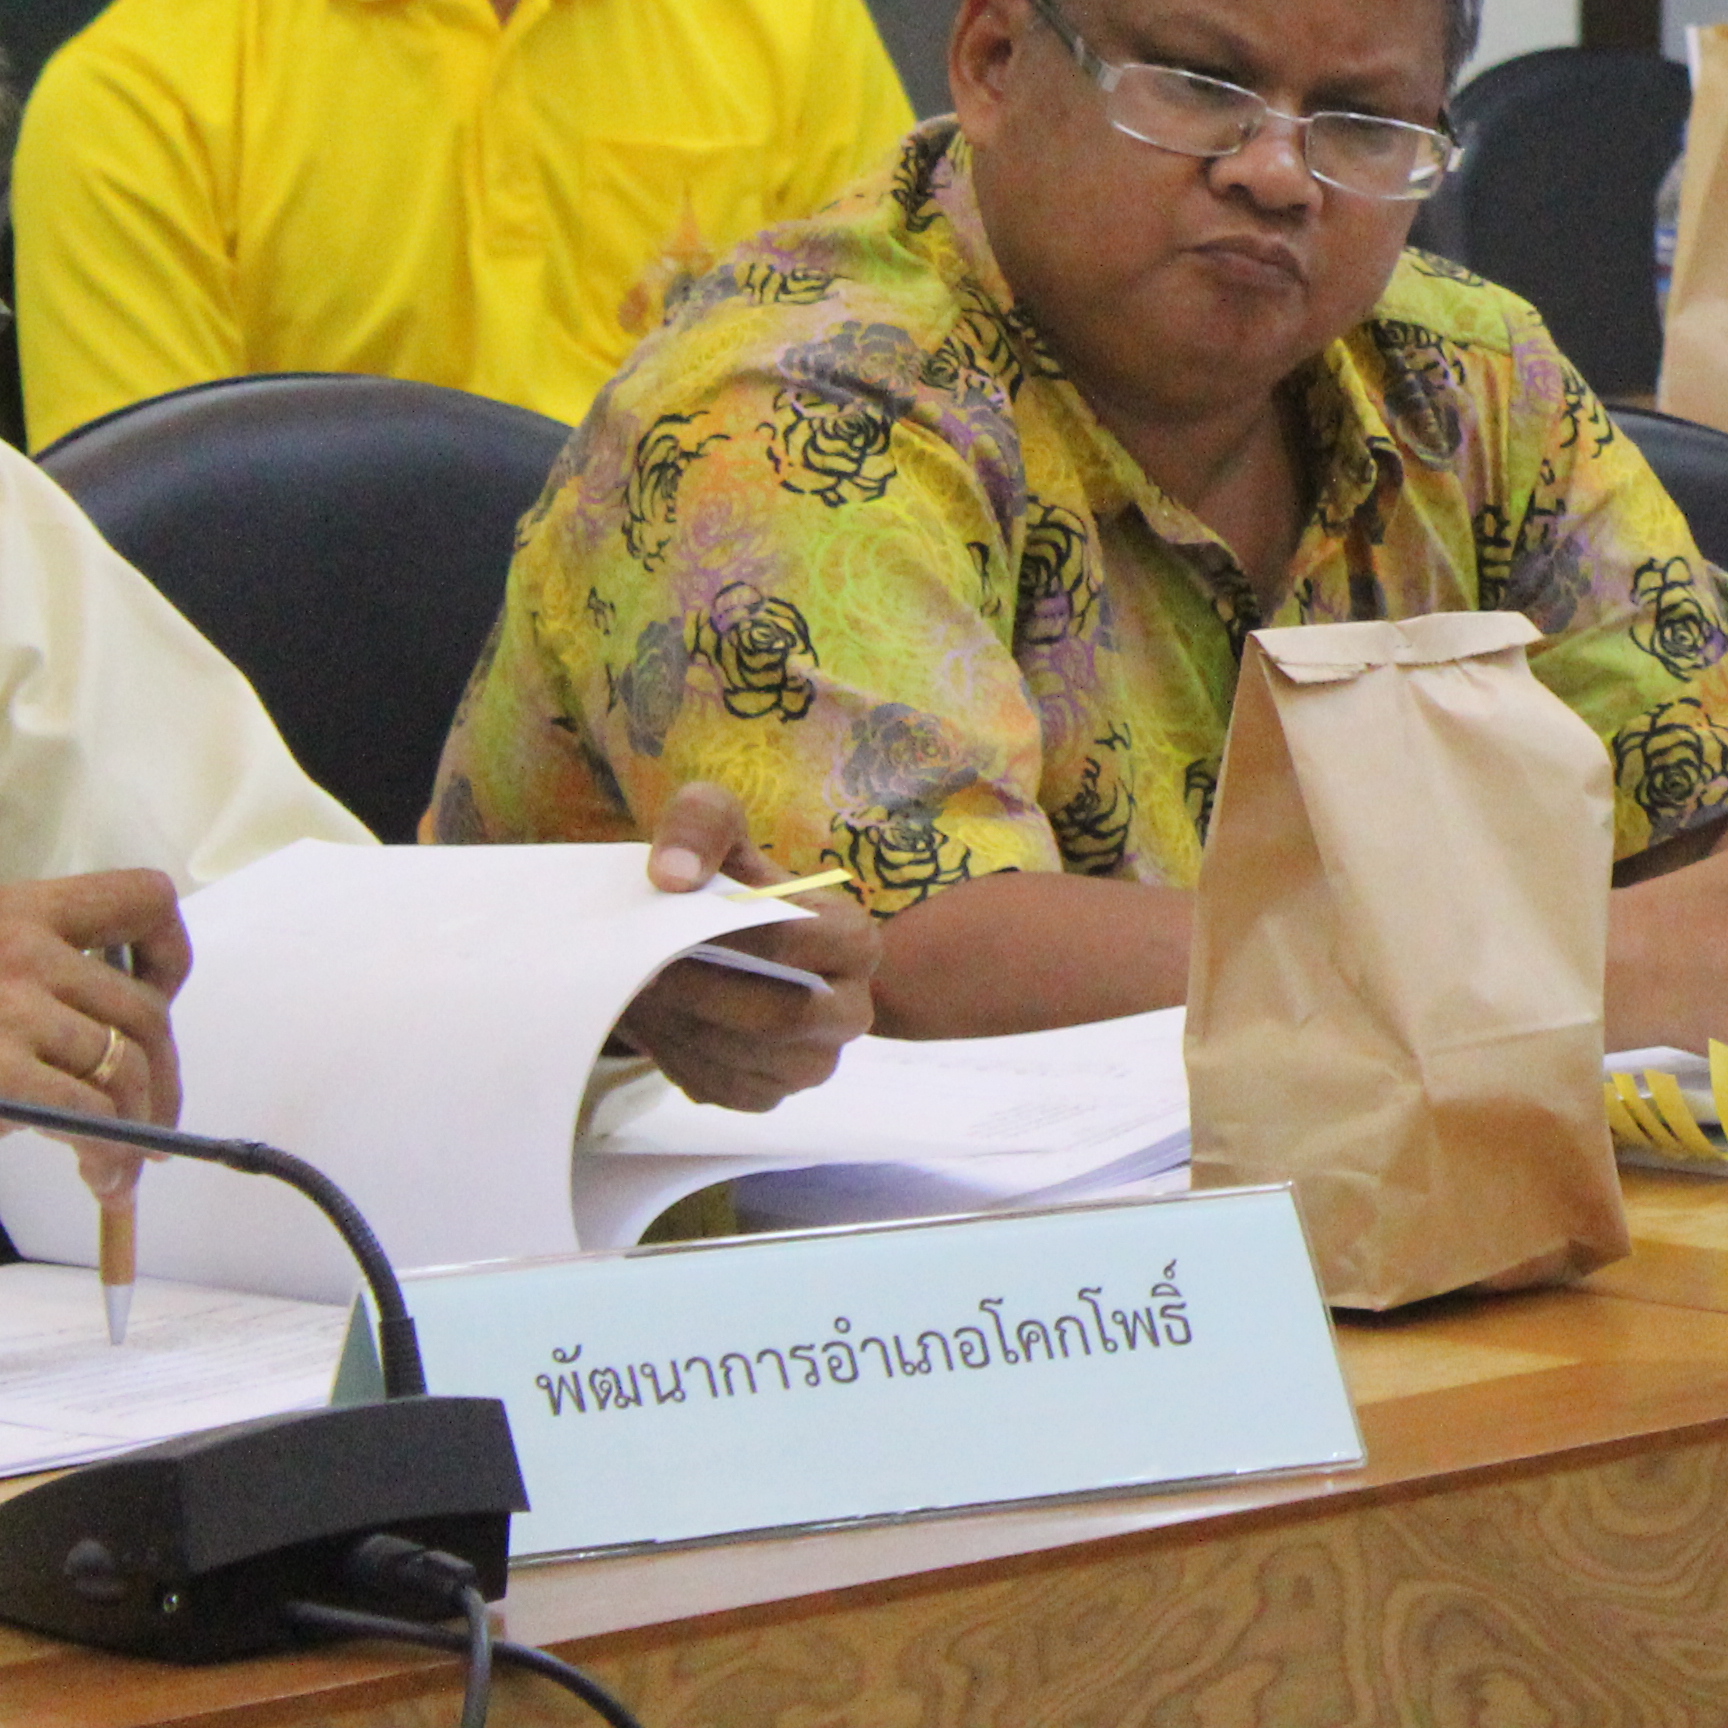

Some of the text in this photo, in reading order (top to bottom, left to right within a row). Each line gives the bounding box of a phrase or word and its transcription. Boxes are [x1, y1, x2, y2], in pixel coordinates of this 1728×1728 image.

[534, 1258, 1195, 1418] พัฒนาการอำเภอโคกโพธิ์
